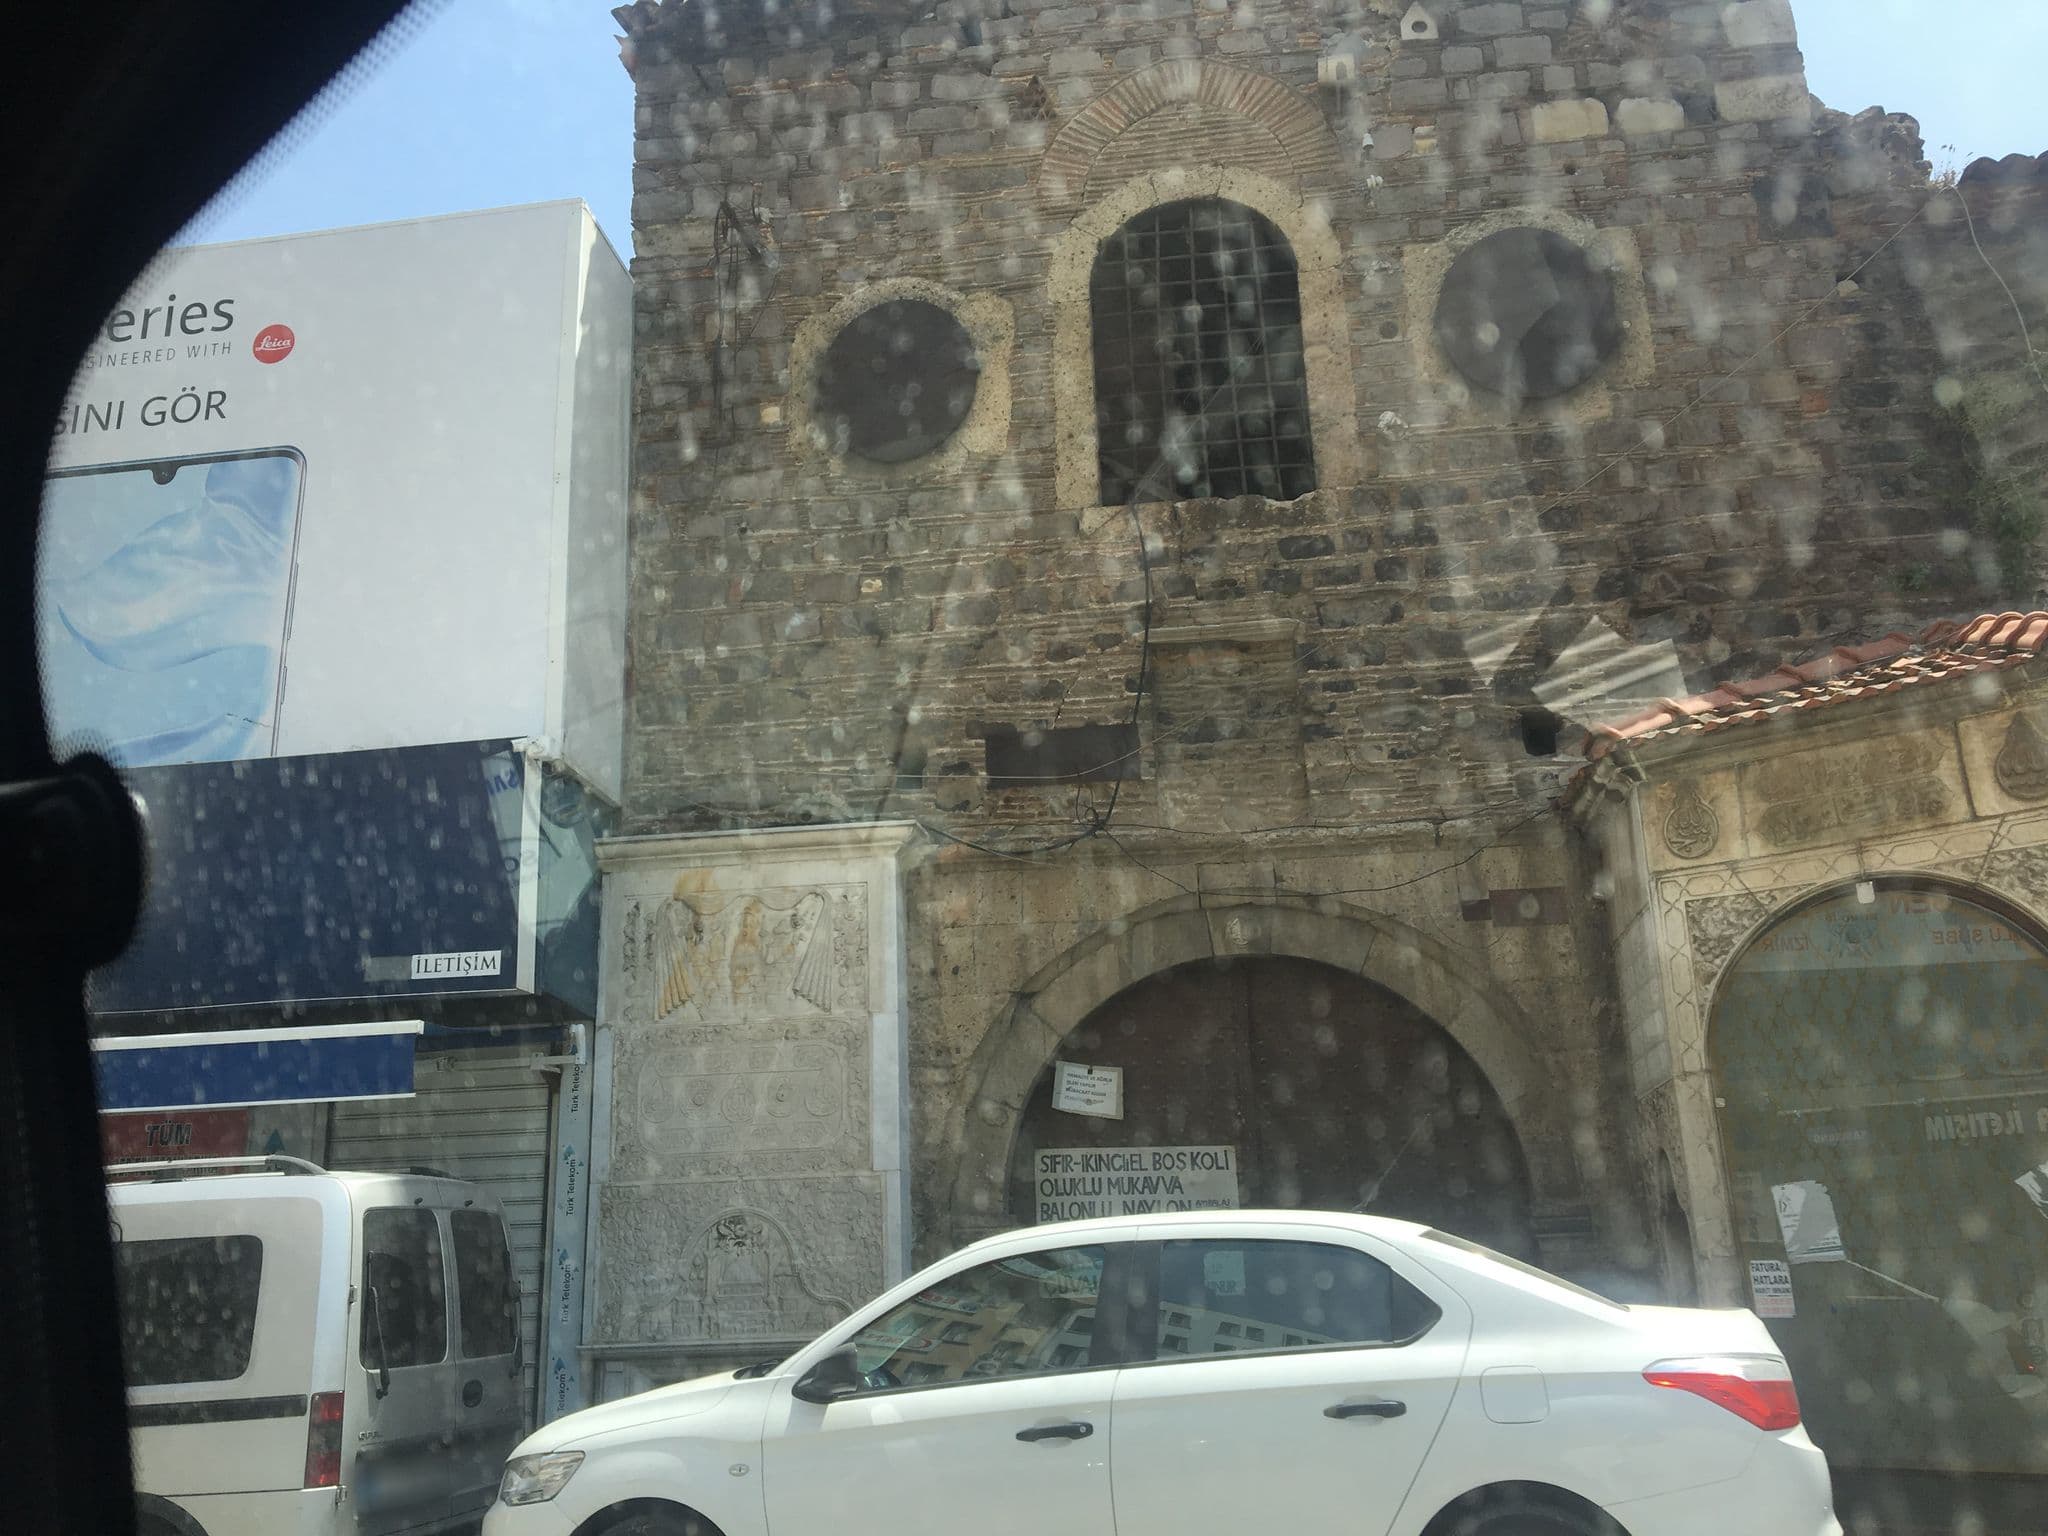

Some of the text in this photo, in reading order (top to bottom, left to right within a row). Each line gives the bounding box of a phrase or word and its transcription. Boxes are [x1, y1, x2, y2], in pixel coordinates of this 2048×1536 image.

[106, 294, 235, 343] eries
[86, 341, 232, 369] GINEERED WITH
[256, 335, 292, 352] Leica
[53, 386, 228, 436] SINI GÖR
[416, 952, 497, 976] İLETİŞİM
[145, 1119, 193, 1147] TÜM
[566, 1159, 576, 1196] Telekom
[1040, 1175, 1184, 1197] OLUKLU MUKAVVA
[562, 1263, 572, 1302] Telekom
[557, 1373, 567, 1412] Telekom
